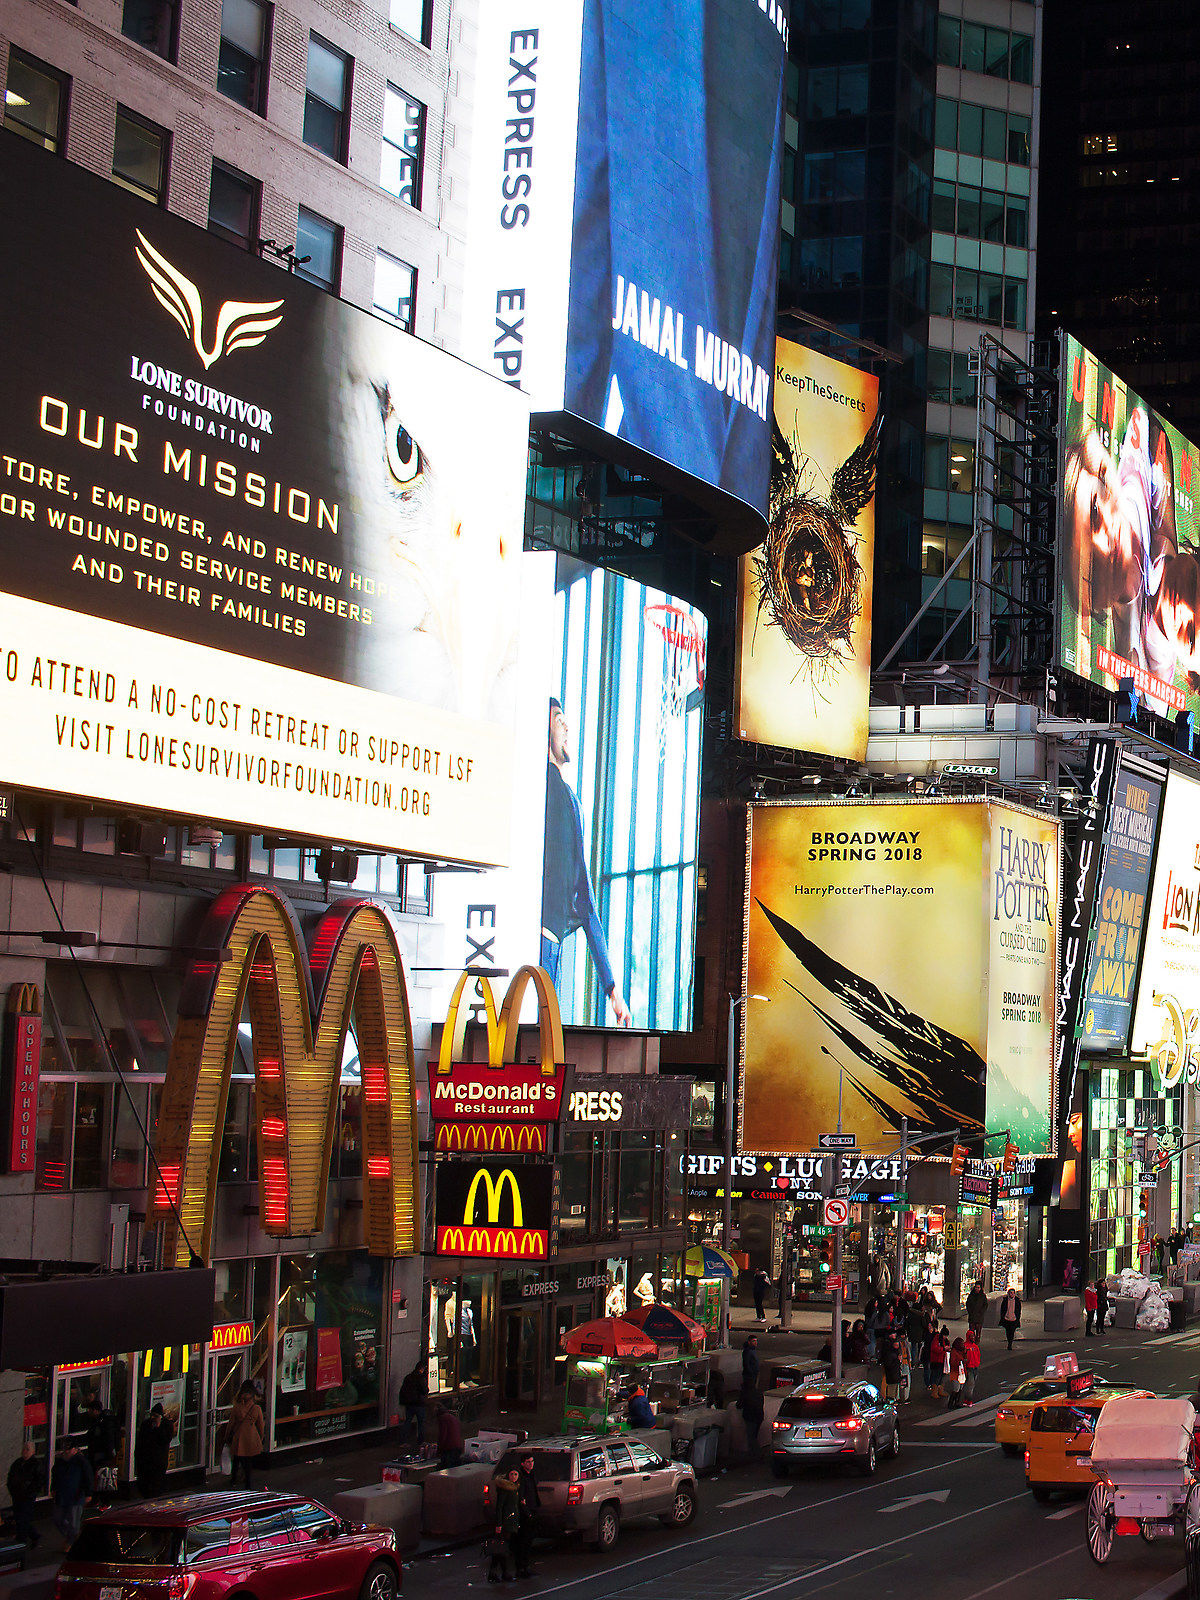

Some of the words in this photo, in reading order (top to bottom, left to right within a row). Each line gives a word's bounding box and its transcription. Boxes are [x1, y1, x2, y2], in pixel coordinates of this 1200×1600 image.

[500, 28, 539, 231] EXPRESS
[612, 275, 689, 371] JAMAL
[695, 324, 770, 422] MURRAY
[130, 356, 182, 397] LONE
[184, 378, 273, 434] SURVIVOR
[775, 365, 868, 415] KeepTheSecrets
[142, 394, 260, 453] FOUNDATION
[40, 396, 139, 463] OUR
[163, 441, 339, 534] MISSION
[91, 485, 213, 544] EMPOWER,
[222, 531, 266, 559] AND
[275, 547, 343, 584] RENEW
[47, 507, 170, 562] WOUNDED
[180, 550, 272, 594] SERVICE
[281, 581, 373, 625] MEMBERS
[71, 553, 124, 584] AND
[133, 570, 201, 607] THEIR
[210, 593, 306, 637] FAMILIES
[1098, 649, 1109, 670] IN
[31, 656, 116, 703] ATTEND
[128, 679, 138, 709] A
[151, 684, 241, 731] NO-COST
[251, 708, 329, 751] RETREAT
[338, 729, 359, 758] OR
[368, 735, 440, 776] SUPPORT
[449, 754, 473, 783] LSF
[56, 714, 114, 755] VISIT
[126, 729, 430, 816] LONESURVIVORFOUNDATION.ORG
[808, 848, 877, 862] SPRING
[884, 847, 923, 861] 2018
[811, 831, 921, 846] BROADWAY
[999, 826, 1051, 884] HARRY
[794, 884, 934, 897] HarryPotterThePlay.com
[994, 871, 1052, 926] POTTER
[1102, 885, 1144, 927] COME
[1163, 869, 1194, 930] LION
[1000, 931, 1025, 950] CURSED
[1026, 936, 1047, 954] CHILD
[1090, 958, 1136, 998] AWAY
[1001, 1008, 1027, 1022] SPRING
[1027, 1009, 1042, 1024] 2018
[1002, 991, 1041, 1007] BROADWAY
[24, 1024, 35, 1076] OPEN
[20, 1081, 34, 1092] 24
[434, 1081, 556, 1100] McDonald's
[569, 1091, 623, 1121] RESS
[455, 1103, 535, 1114] Restaurant
[20, 1097, 31, 1165] HOURS
[778, 1157, 909, 1181] LUGAGE
[751, 1190, 787, 1200] Canon
[796, 1191, 829, 1200] SON
[817, 1227, 826, 1235] 46
[523, 1281, 560, 1296] EXPRESS
[577, 1274, 610, 1289] EXPRESS
